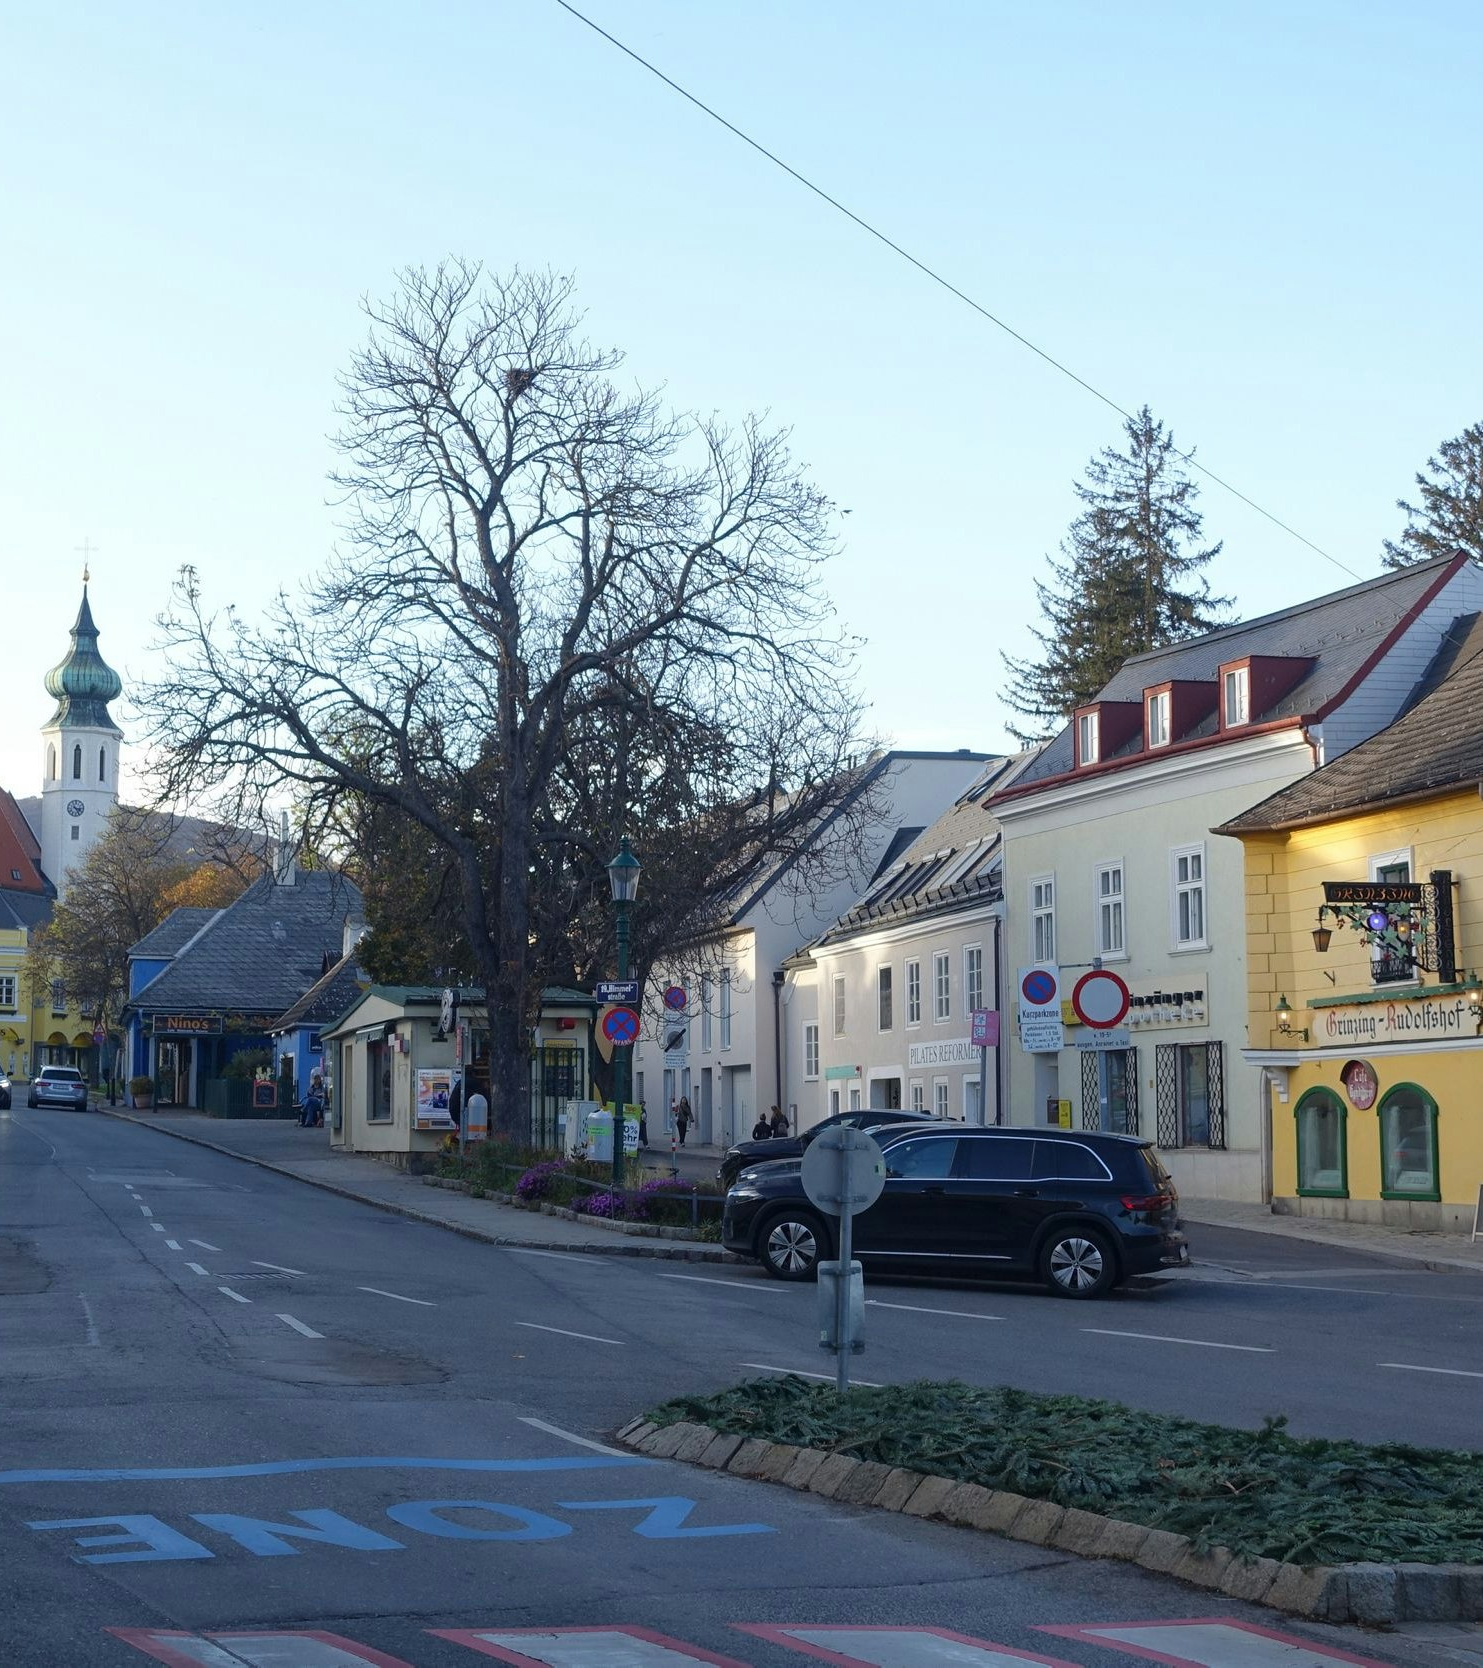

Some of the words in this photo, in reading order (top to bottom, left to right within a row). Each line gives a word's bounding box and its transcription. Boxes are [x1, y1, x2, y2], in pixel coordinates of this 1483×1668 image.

[607, 992, 626, 1000] straße
[1022, 1009, 1059, 1019] Kurzparkzone
[167, 1017, 209, 1029] Nino's
[910, 1046, 938, 1064] PILATES
[25, 1496, 778, 1564] ZONE
